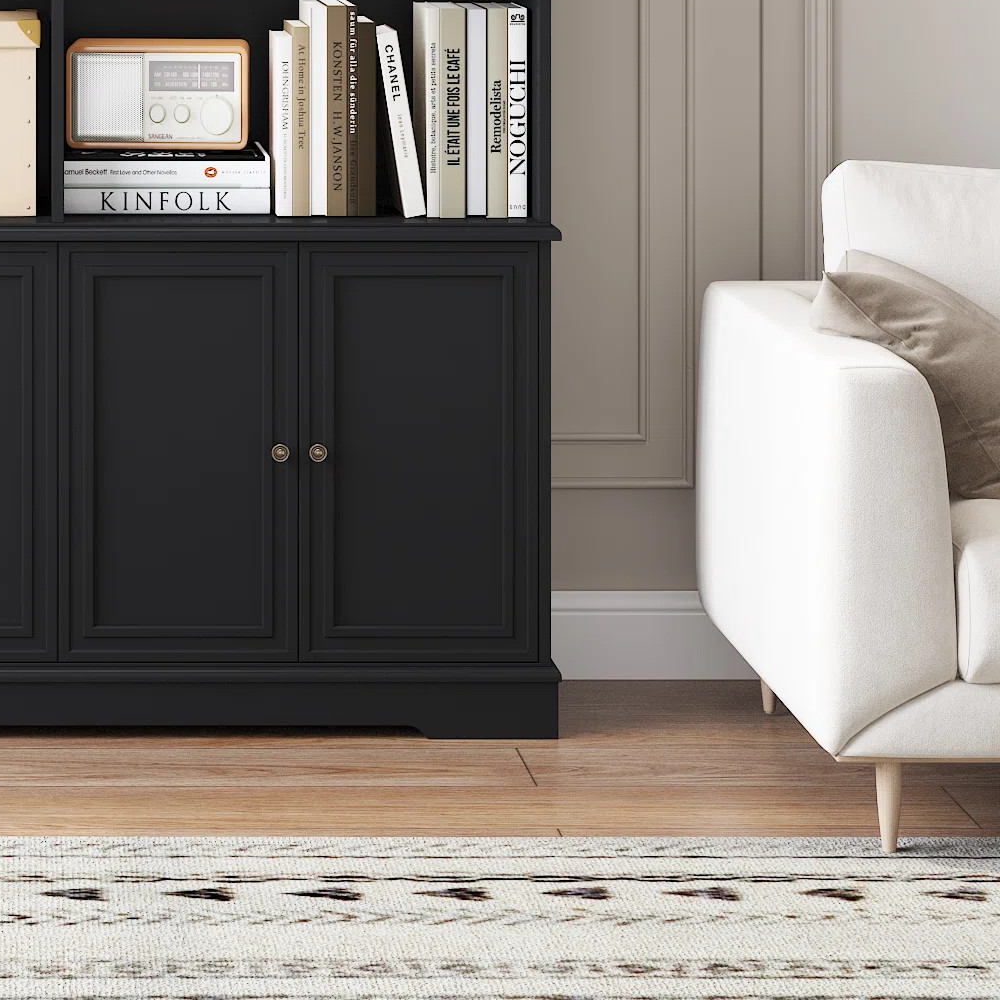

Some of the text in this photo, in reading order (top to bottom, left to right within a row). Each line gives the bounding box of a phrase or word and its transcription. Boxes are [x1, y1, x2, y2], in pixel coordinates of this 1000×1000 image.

[281, 61, 289, 87] JOHN
[296, 44, 306, 150] At Home in Joshua Tree
[333, 42, 342, 101] KONSTEN
[349, 11, 357, 134] saum für alla die sünderin
[384, 44, 401, 102] CHANEL
[445, 48, 460, 166] IL ÉTAIT UNE FOIS LE CAFÉ
[490, 80, 502, 153] Remodelista
[510, 60, 526, 175] NOGUCHI
[101, 192, 232, 211] KINFOLK
